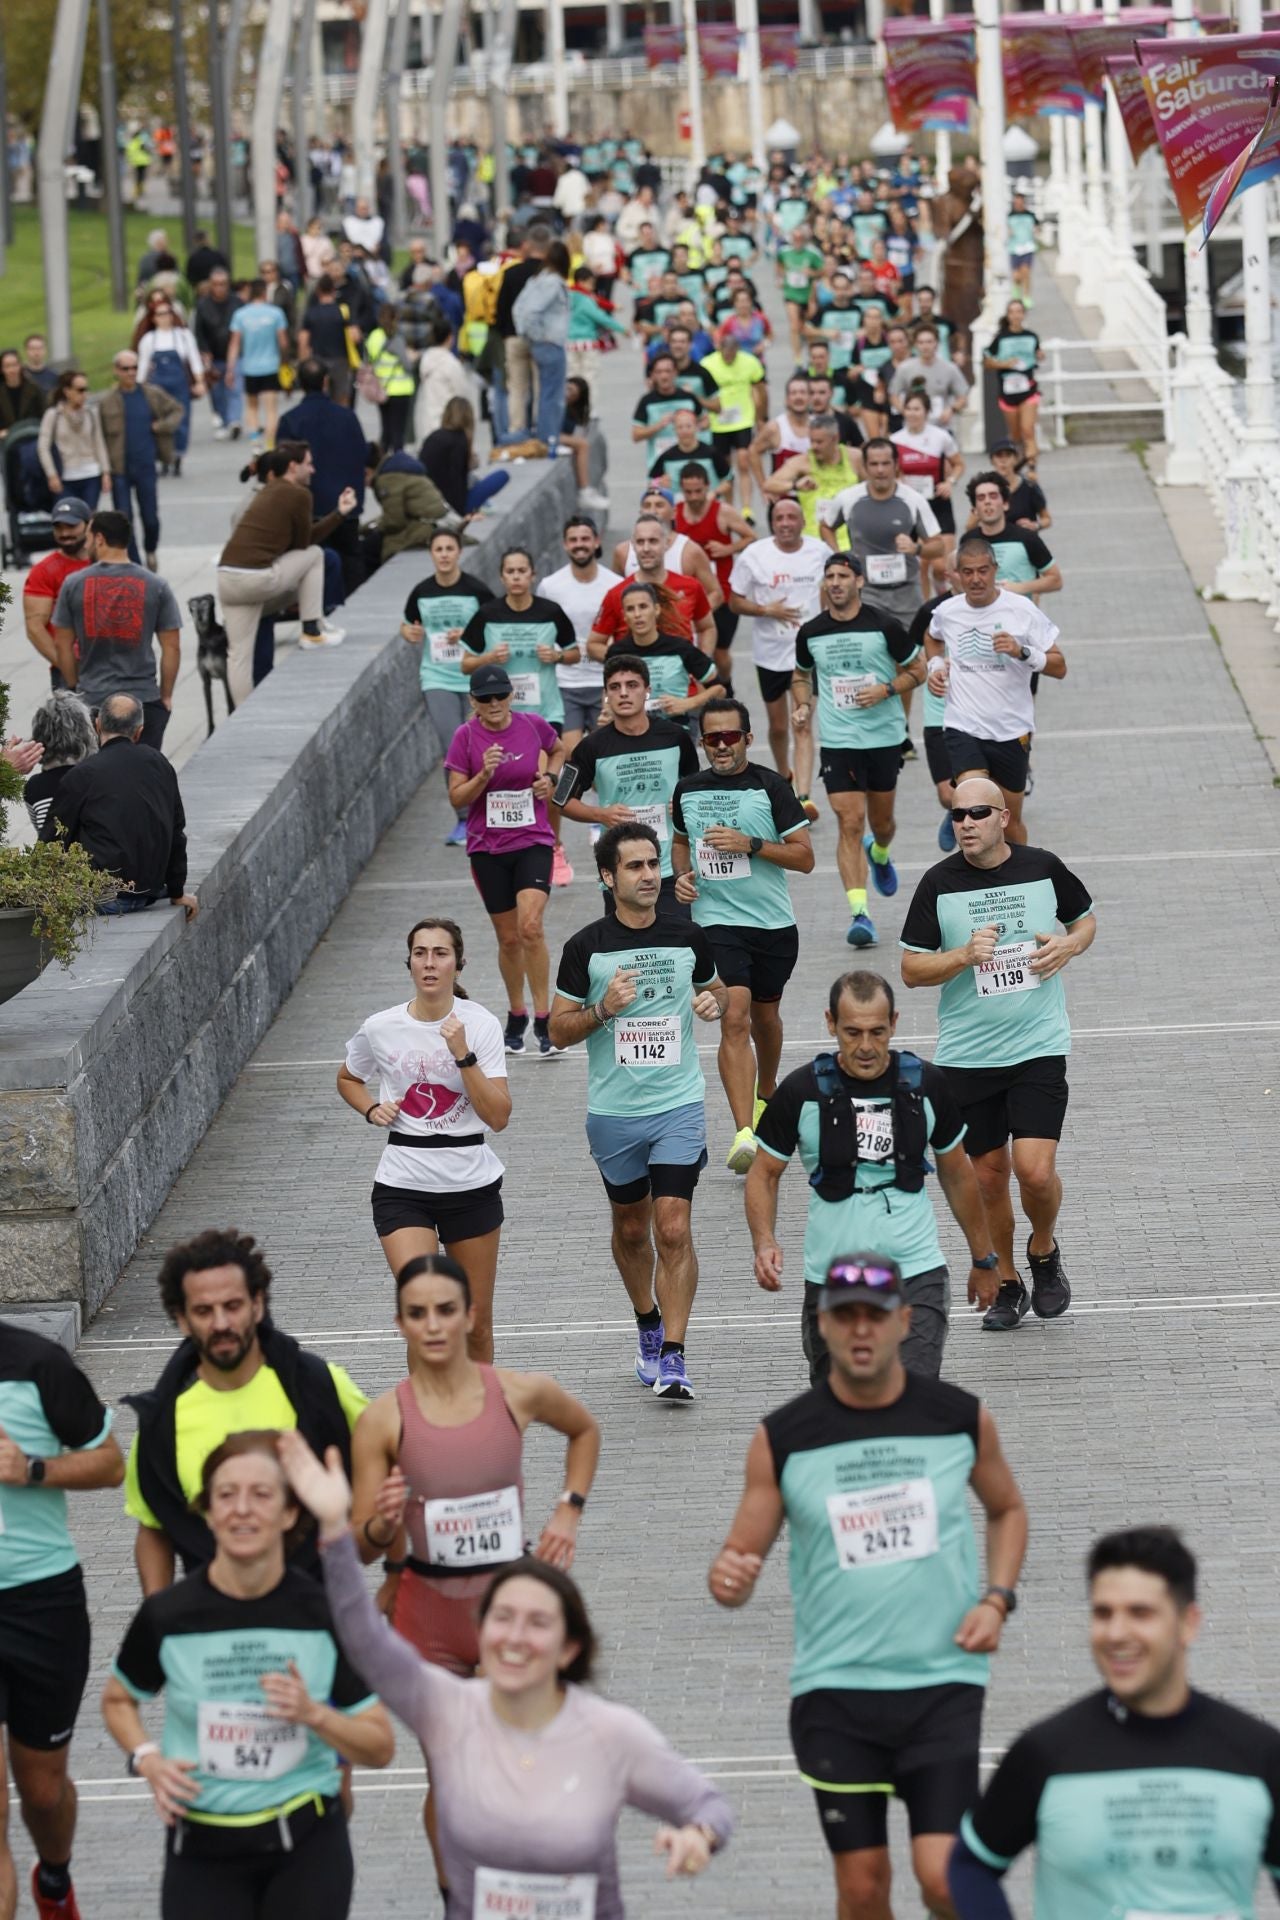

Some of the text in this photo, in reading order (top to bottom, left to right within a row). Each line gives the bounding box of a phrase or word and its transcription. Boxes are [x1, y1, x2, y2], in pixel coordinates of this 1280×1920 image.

[1148, 56, 1203, 94] Fair
[501, 810, 524, 822] 1635
[699, 850, 718, 860] XXXVI
[708, 861, 734, 874] 1167
[984, 890, 1007, 899] XXXVI
[968, 902, 1026, 916] CARRERA INTERNACIONAL
[634, 953, 657, 961] XXXVI
[993, 946, 1022, 956] CORREO
[641, 967, 675, 976] NTERNACIONAL
[979, 960, 1005, 974] XXXVI
[993, 969, 1024, 988] 1139
[620, 1031, 647, 1042] XXXVI
[633, 1044, 665, 1059] 1142
[857, 1131, 892, 1152] 2188
[455, 1532, 501, 1556] 2140
[862, 1526, 914, 1553] 2472
[234, 1746, 273, 1768] 547
